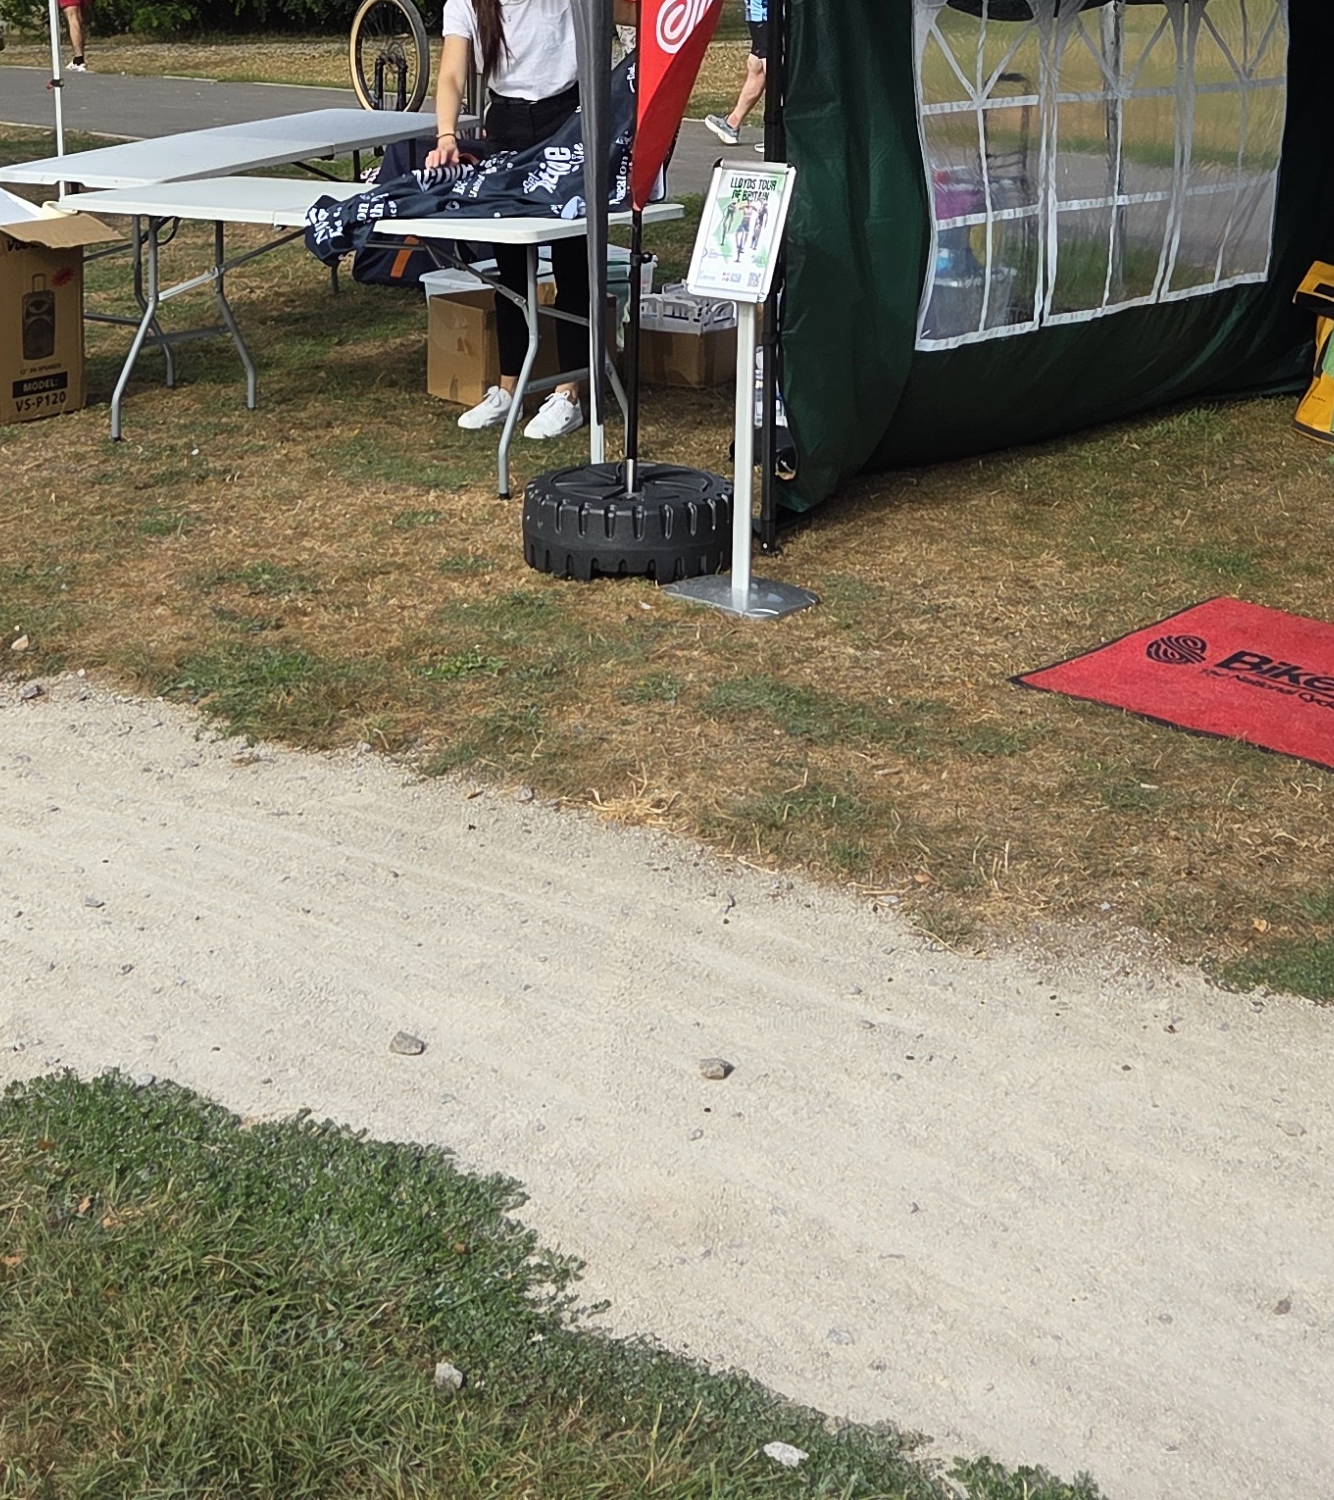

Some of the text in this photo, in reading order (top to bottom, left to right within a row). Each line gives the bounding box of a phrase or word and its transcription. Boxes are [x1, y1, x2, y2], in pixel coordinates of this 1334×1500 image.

[730, 177, 777, 191] LLOYDS TOUR
[23, 378, 59, 393] MODEL:
[15, 390, 67, 413] VS-P120
